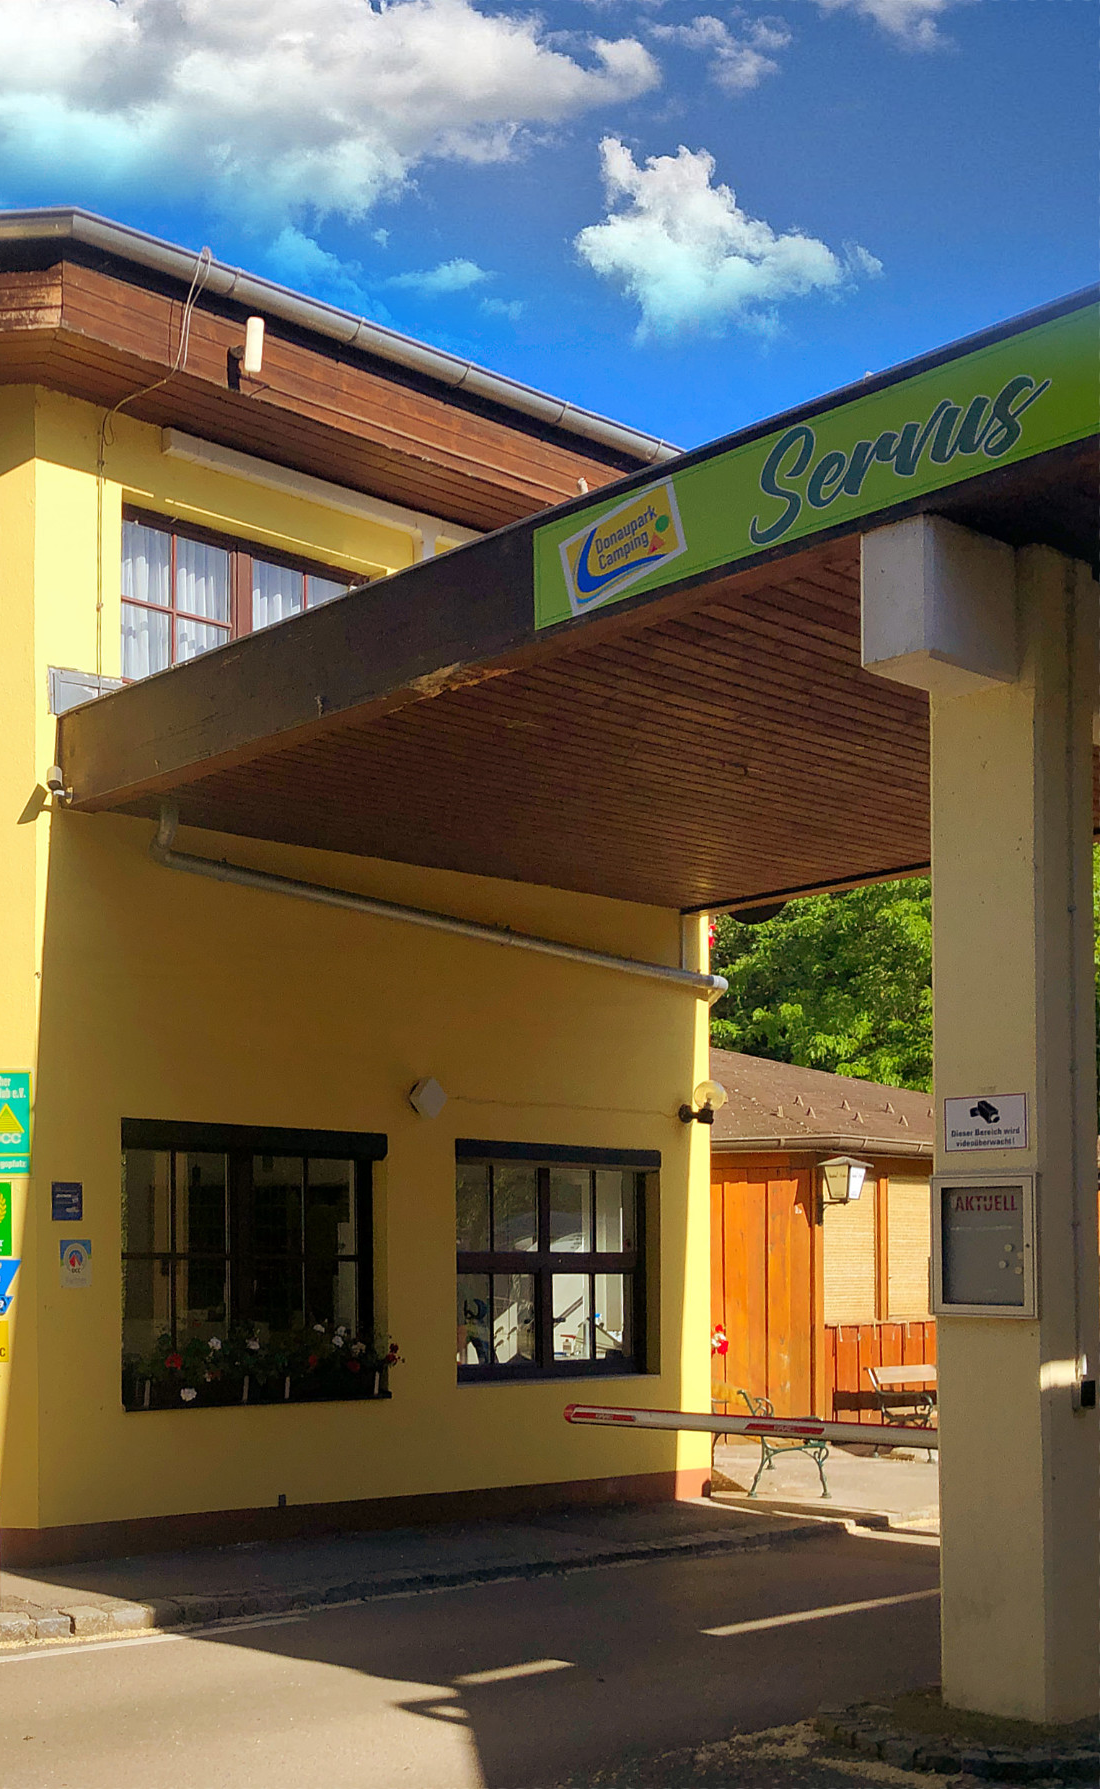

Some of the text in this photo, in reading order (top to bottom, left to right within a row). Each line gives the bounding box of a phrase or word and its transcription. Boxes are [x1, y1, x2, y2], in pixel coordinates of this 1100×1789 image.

[749, 374, 1053, 546] Servus
[595, 505, 658, 554] Donaupark
[598, 531, 649, 570] Camping
[951, 1126, 1020, 1138] Dieser Bereich wird
[955, 1195, 1018, 1212] AKTUELL
